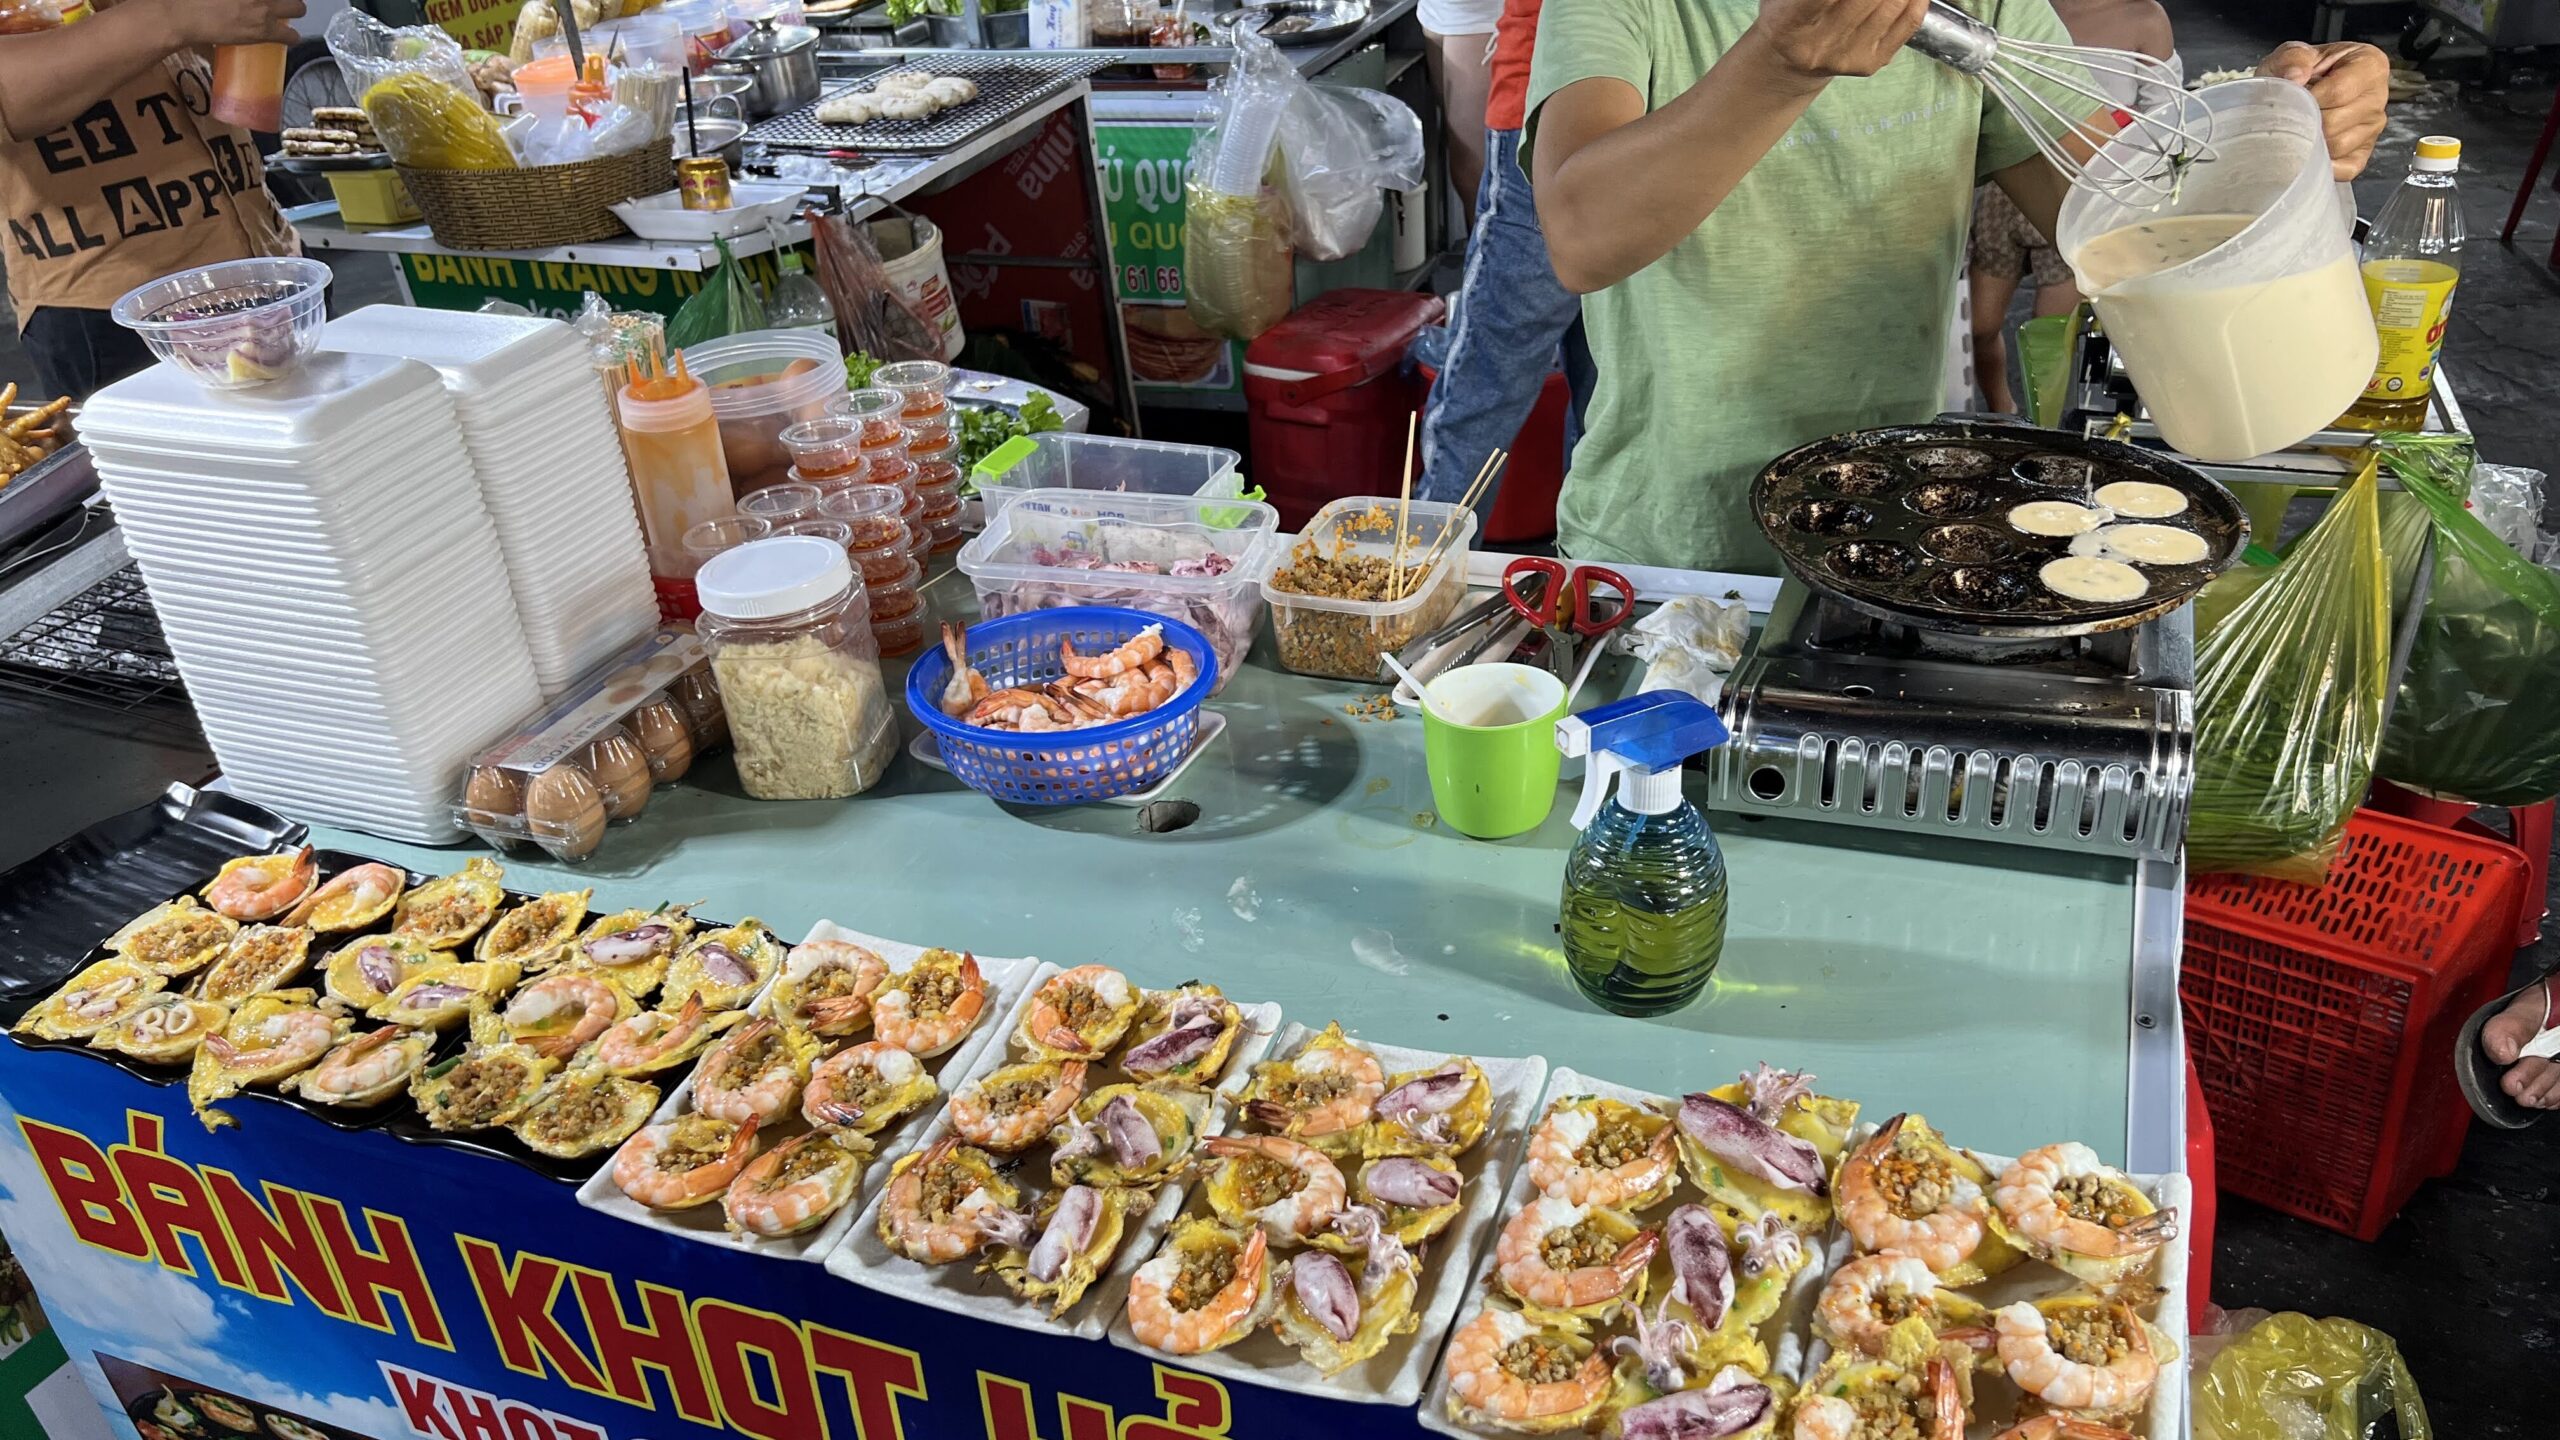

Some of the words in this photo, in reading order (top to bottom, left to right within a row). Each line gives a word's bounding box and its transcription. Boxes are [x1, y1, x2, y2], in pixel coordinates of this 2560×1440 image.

[8, 206, 105, 260] ALL
[1125, 265, 1149, 293] 61
[1154, 266, 1182, 294] 66
[14, 1108, 457, 1352] BÁNH
